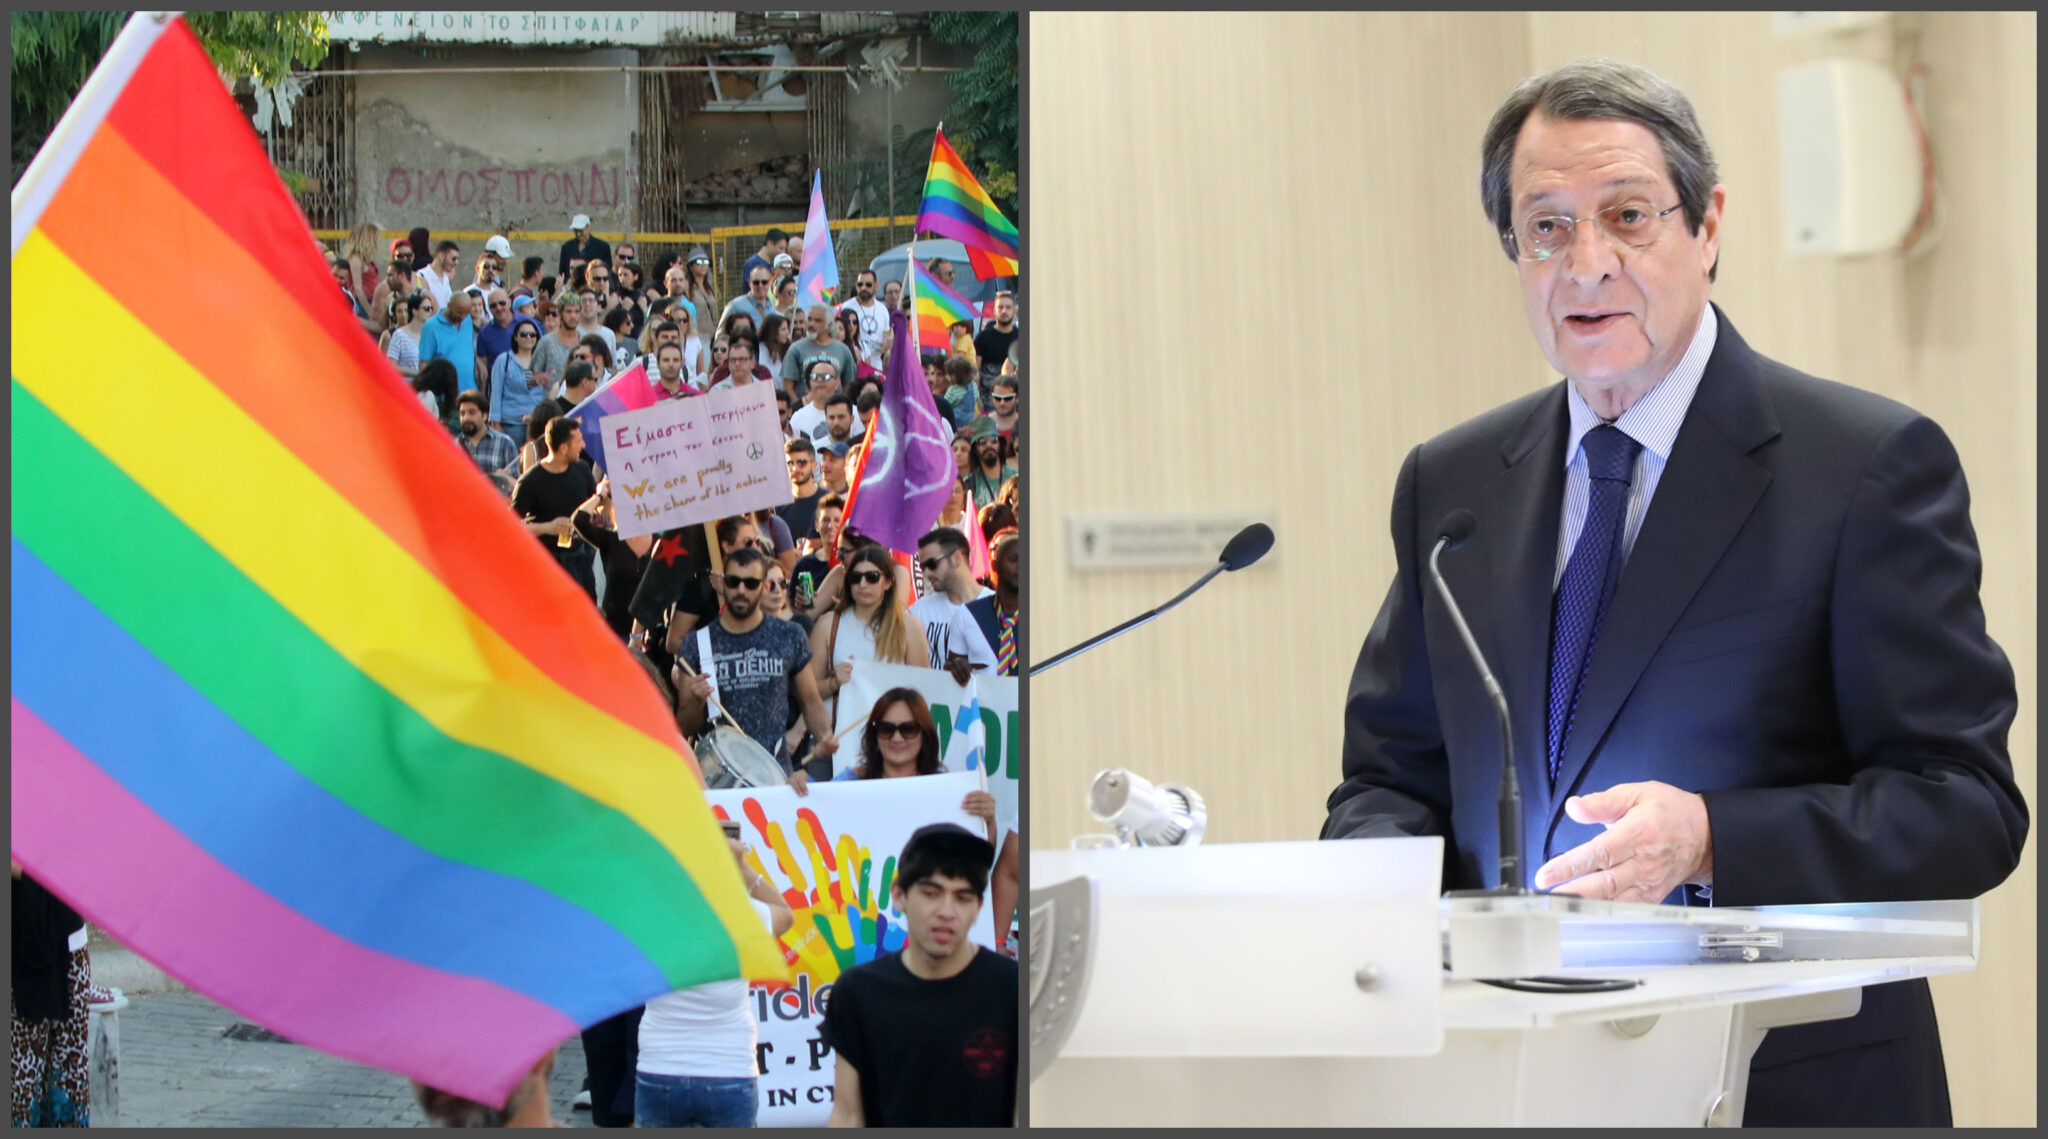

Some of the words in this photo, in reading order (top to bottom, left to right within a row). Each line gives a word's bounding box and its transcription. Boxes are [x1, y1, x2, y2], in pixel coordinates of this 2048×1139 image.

[622, 476, 656, 499] We
[664, 474, 688, 490] are
[633, 503, 660, 521] the
[767, 1087, 797, 1107] IN
[806, 1084, 835, 1104] CY
